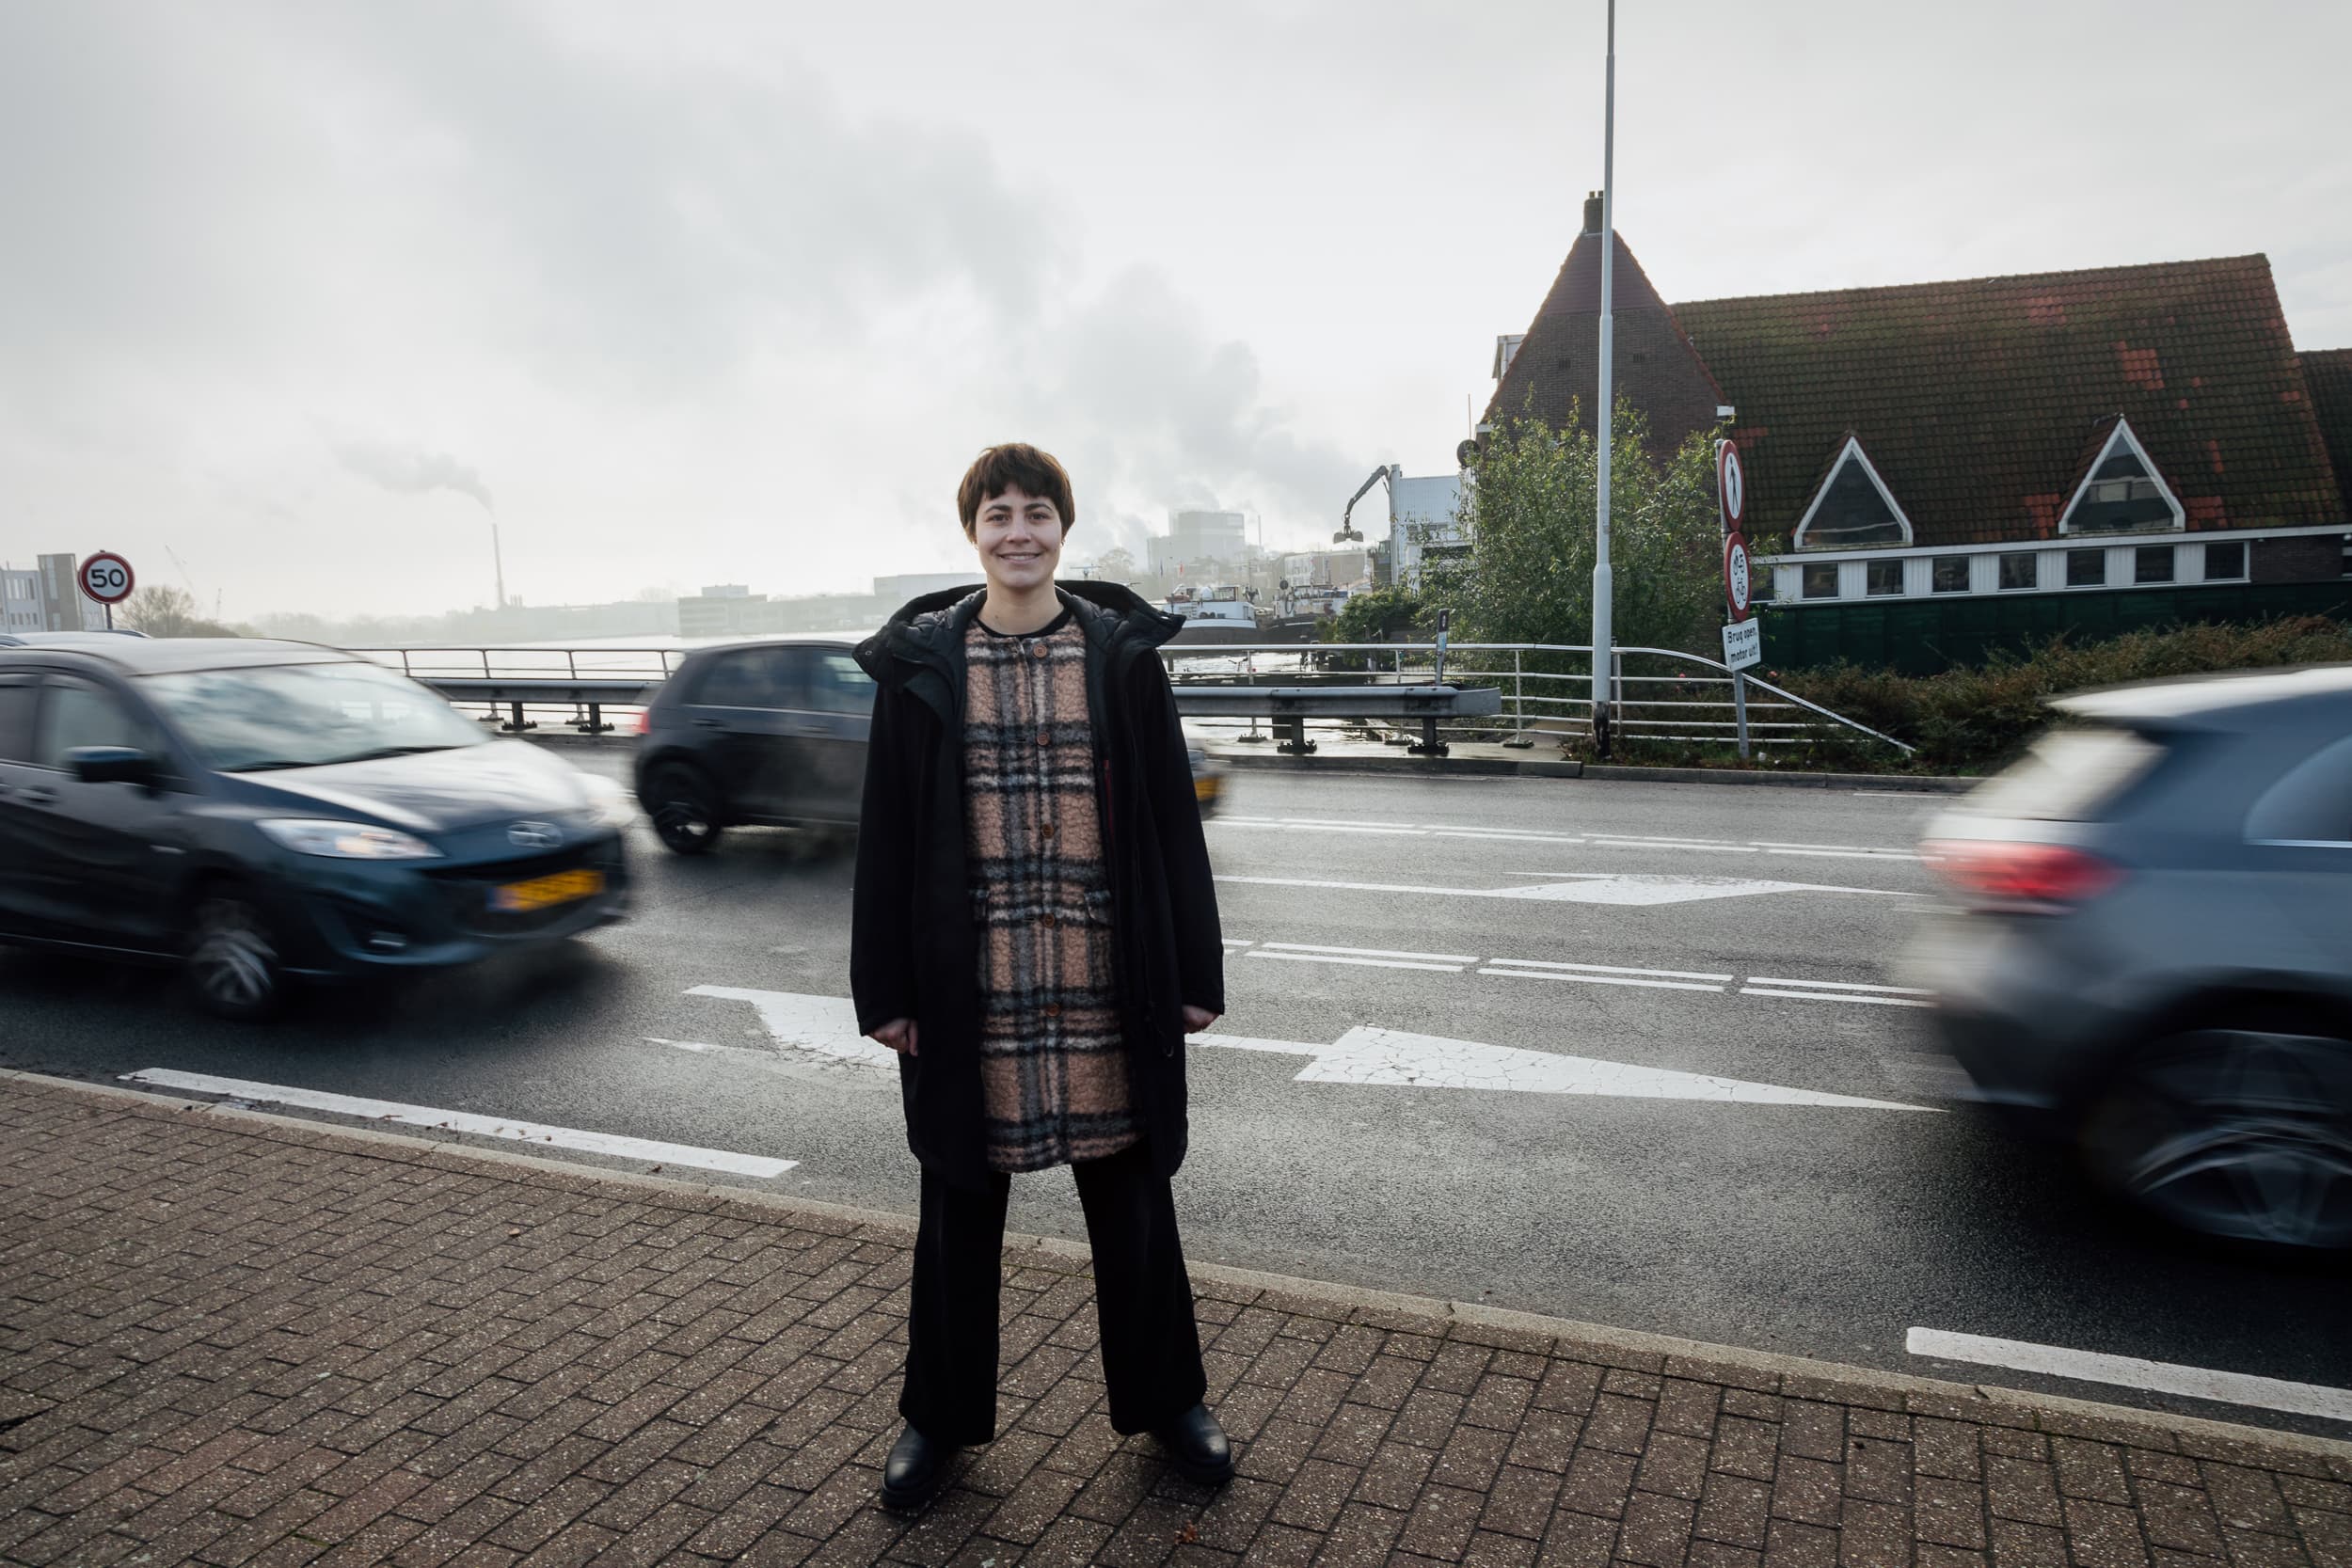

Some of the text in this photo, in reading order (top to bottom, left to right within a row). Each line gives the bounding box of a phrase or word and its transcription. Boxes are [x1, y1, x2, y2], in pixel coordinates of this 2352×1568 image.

[91, 568, 125, 588] 50
[1727, 631, 1743, 643] Brug
[1731, 649, 1748, 662] motor
